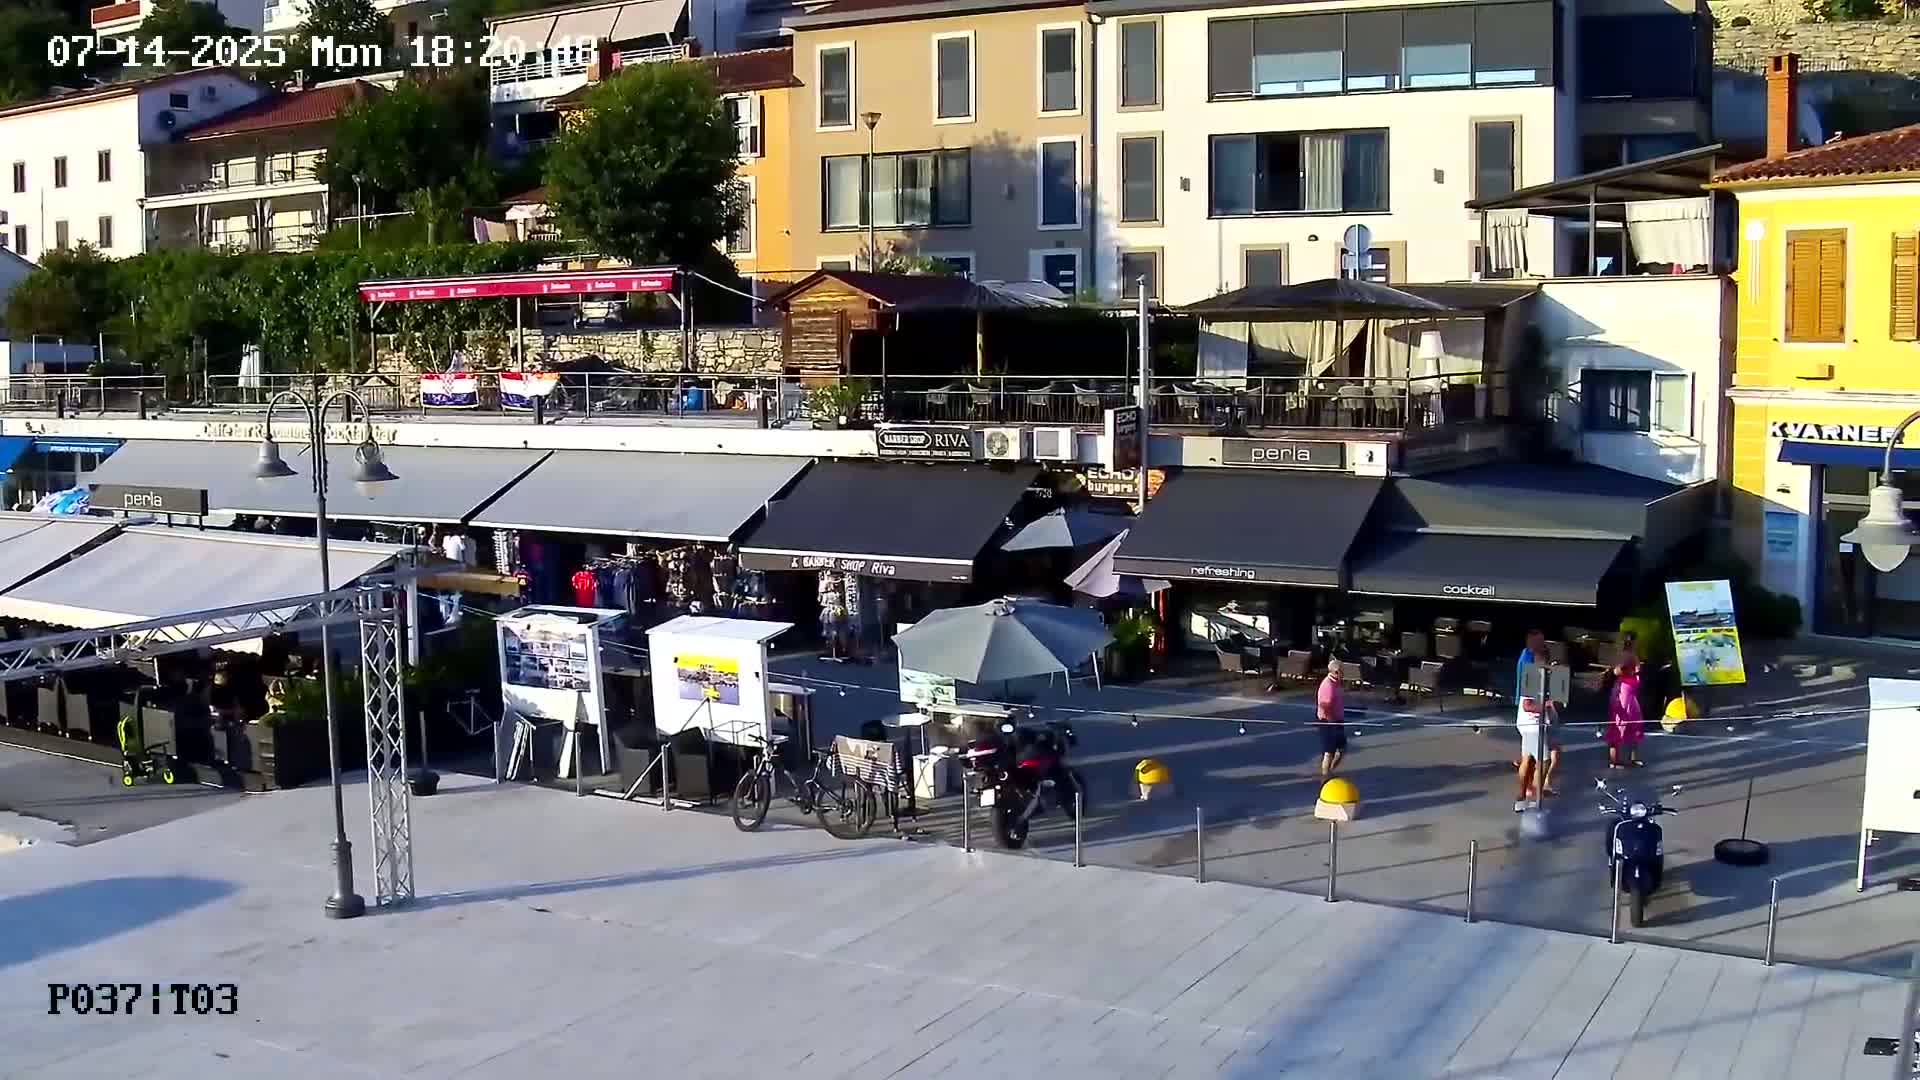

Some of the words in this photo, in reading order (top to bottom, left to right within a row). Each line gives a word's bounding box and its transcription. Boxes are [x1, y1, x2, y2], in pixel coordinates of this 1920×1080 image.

[933, 433, 970, 447] RIVA
[1251, 443, 1311, 462] perla
[1087, 482, 1134, 495] burgers
[123, 491, 163, 508] perla
[802, 556, 836, 569] BARBER
[840, 559, 866, 572] SHOP
[871, 561, 897, 576] Riva
[1190, 566, 1256, 580] refreshing
[1443, 583, 1496, 596] cocktail
